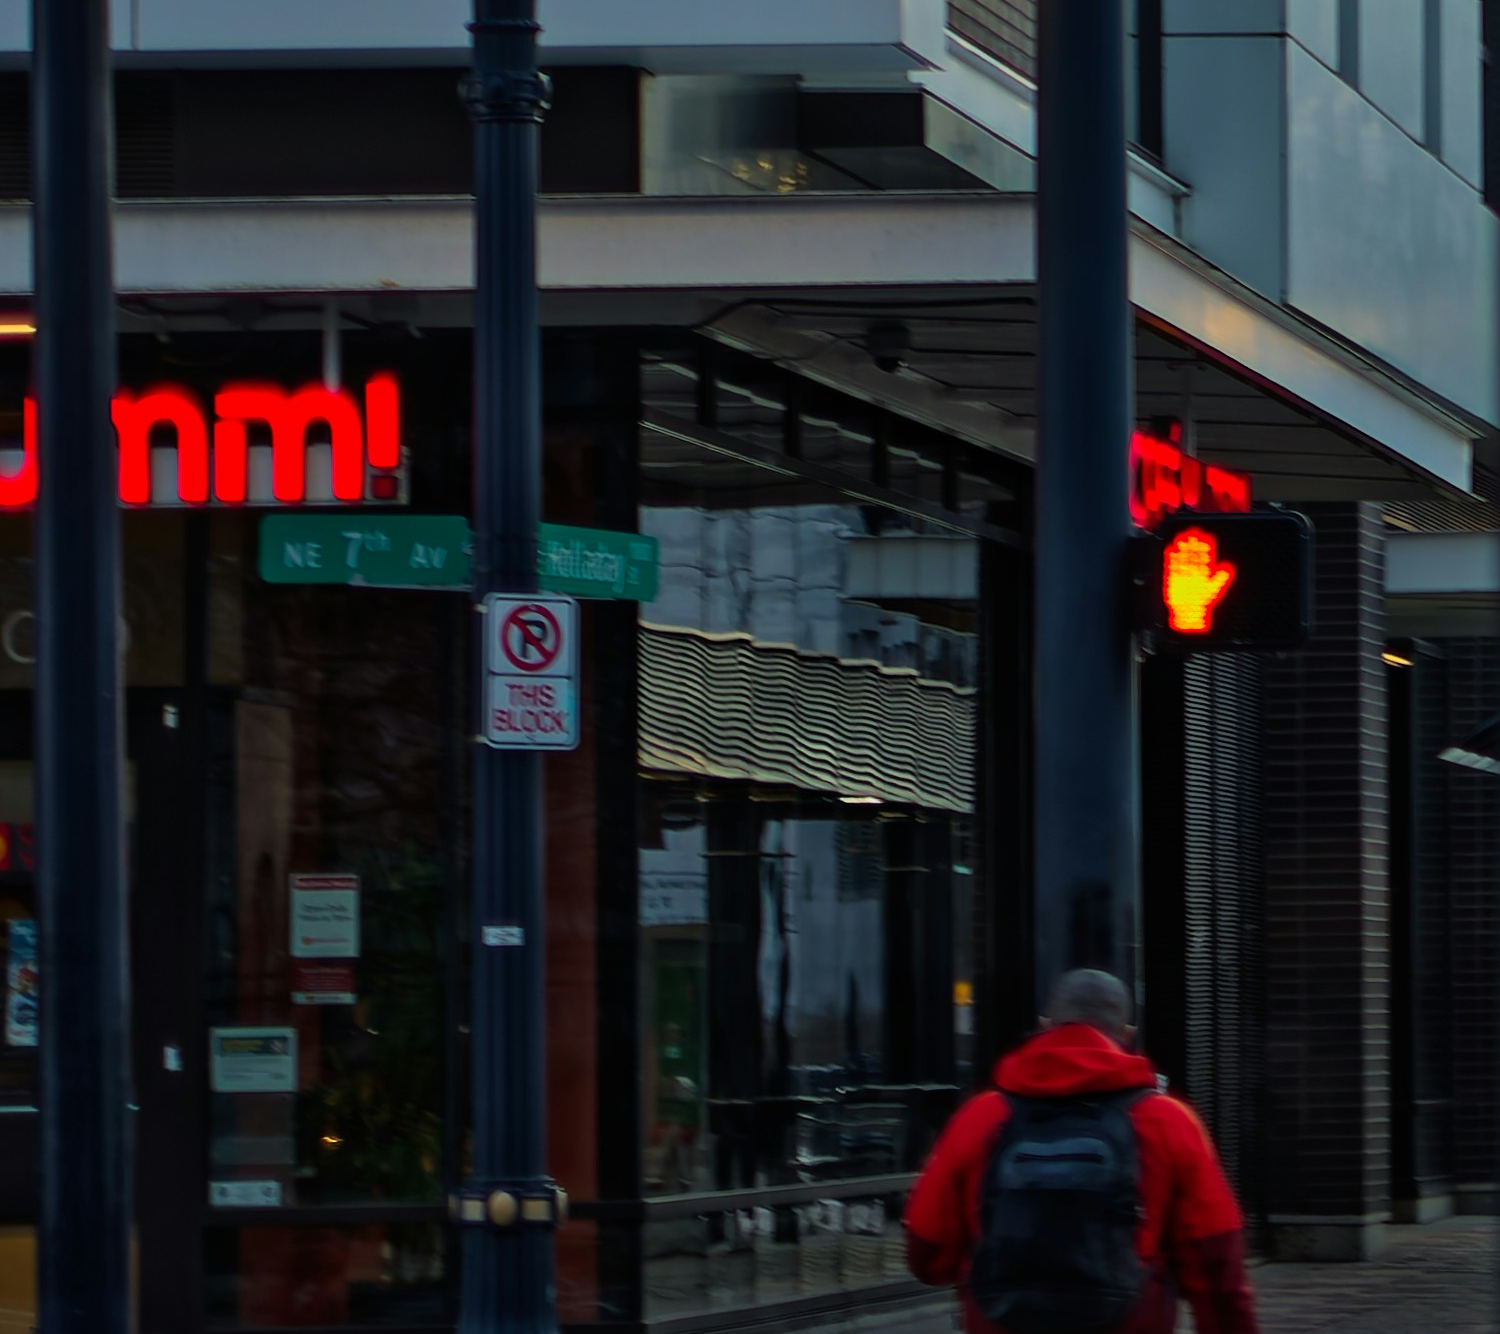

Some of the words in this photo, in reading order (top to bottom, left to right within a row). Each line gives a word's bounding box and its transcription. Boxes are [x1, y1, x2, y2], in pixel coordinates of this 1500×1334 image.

[284, 542, 322, 568] NE
[341, 530, 392, 569] 7th
[505, 683, 556, 708] THIS
[492, 708, 569, 735] BLOCK
